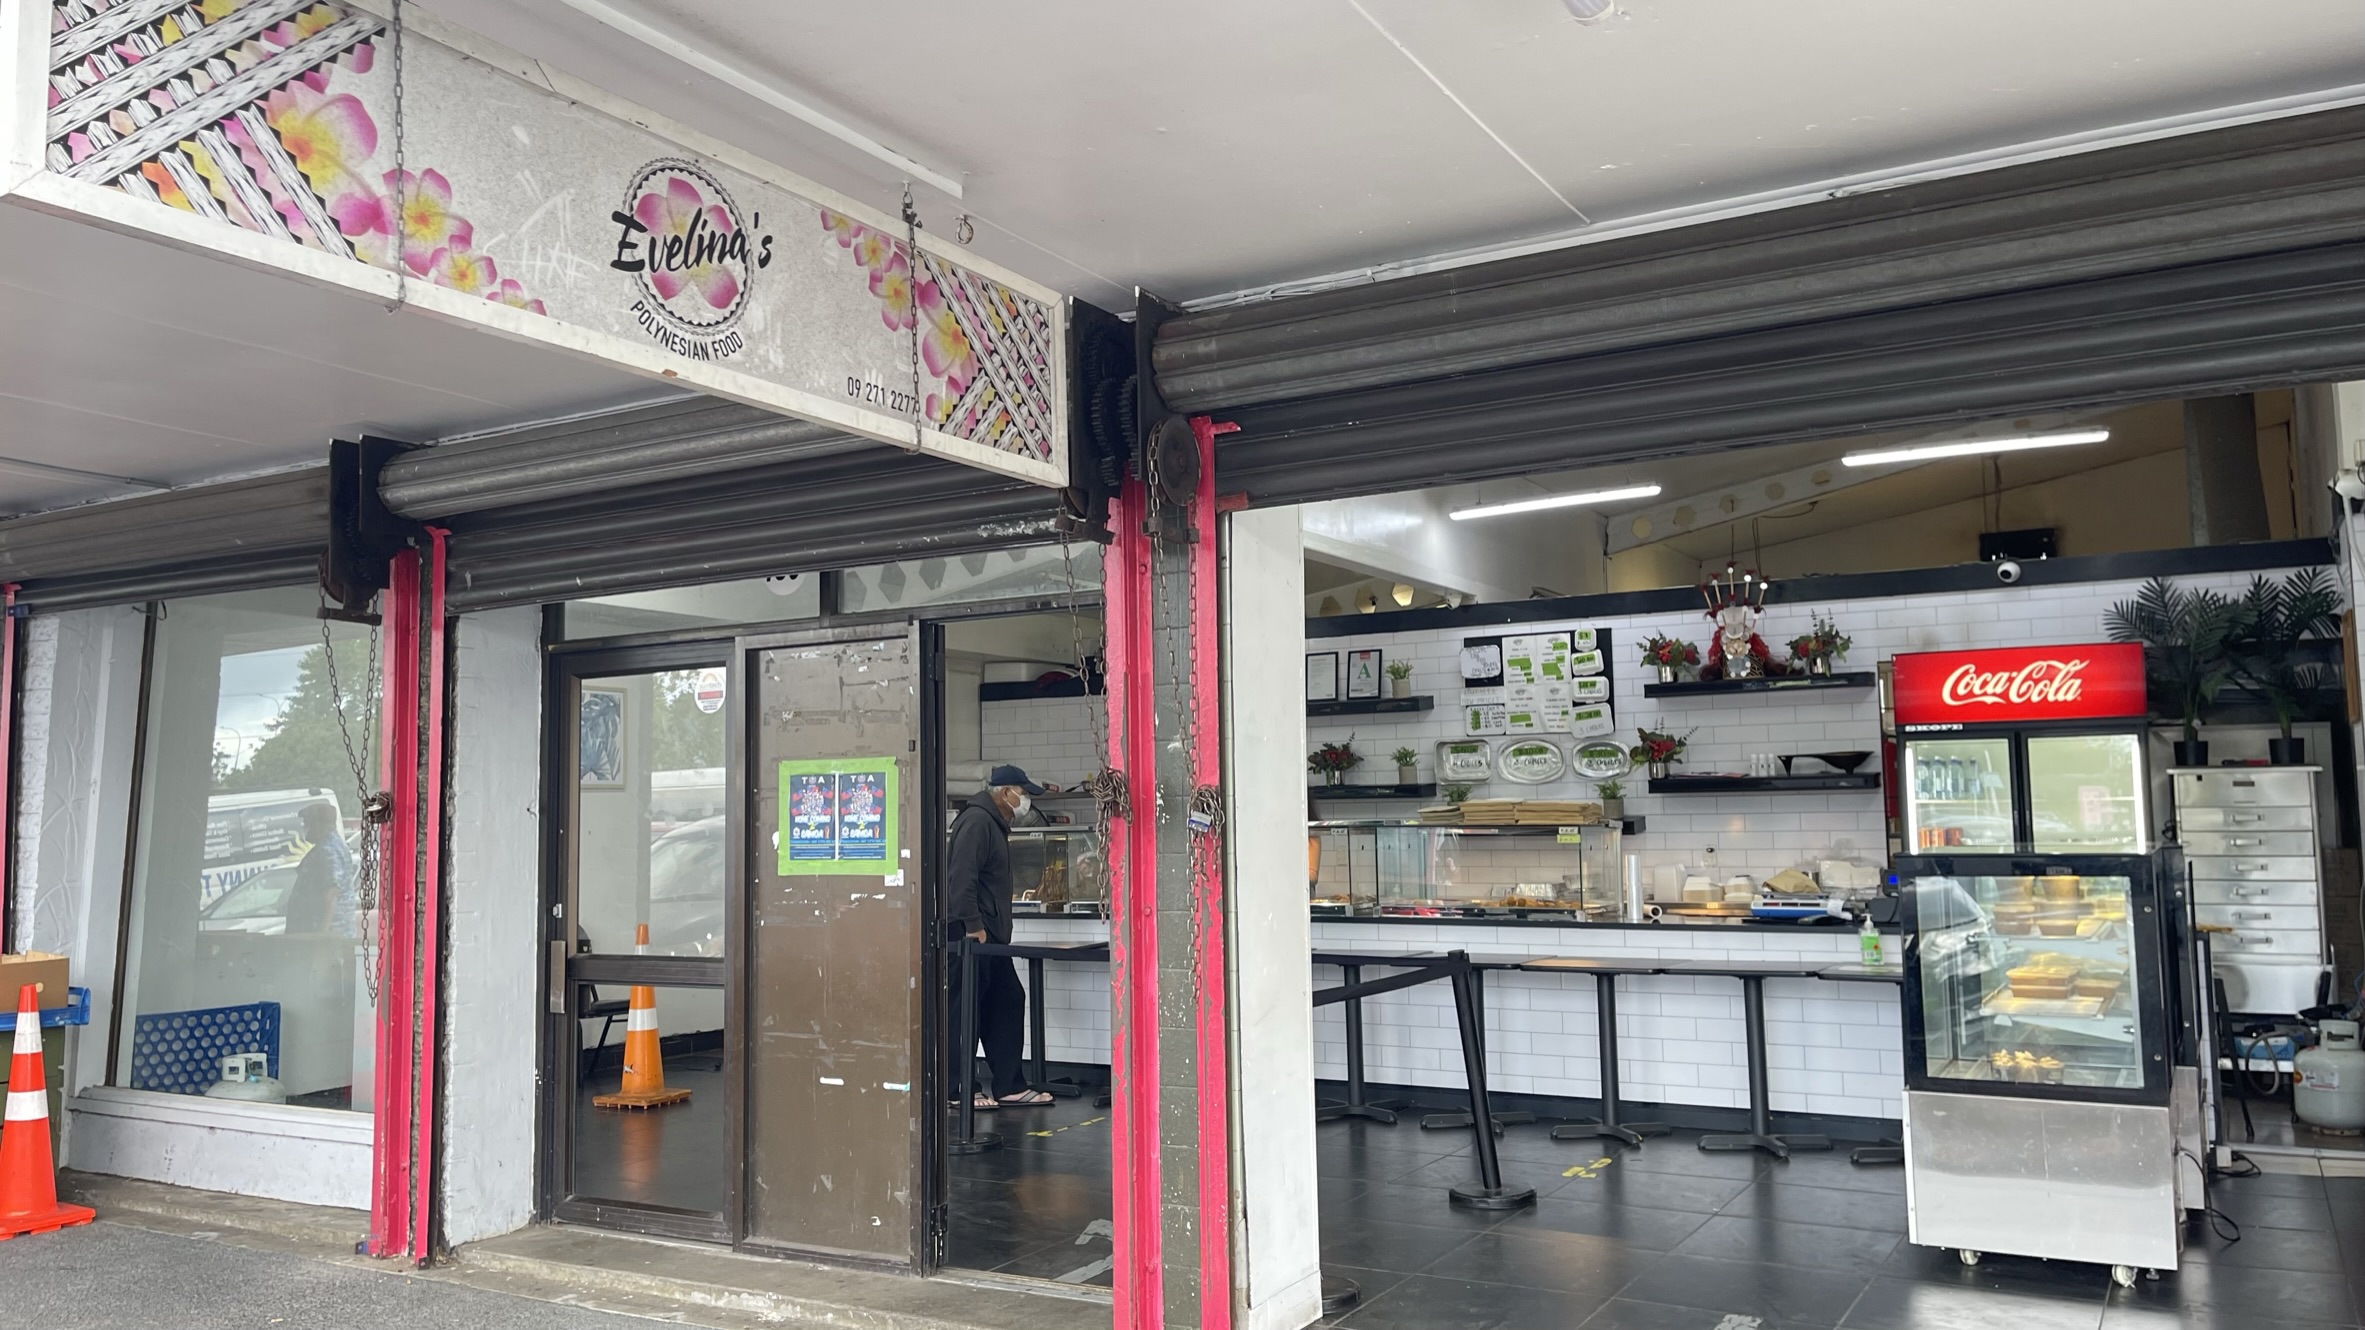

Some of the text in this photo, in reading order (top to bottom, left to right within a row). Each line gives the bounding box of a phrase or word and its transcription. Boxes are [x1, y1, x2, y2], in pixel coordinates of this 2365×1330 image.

[610, 207, 773, 273] Evelina's
[630, 300, 743, 361] POLYNESIAN FOOD
[848, 376, 918, 415] 09 271 2277
[1357, 662, 1372, 679] A
[1941, 659, 2091, 706] Coca-Cola
[1905, 724, 1963, 732] SKOPE
